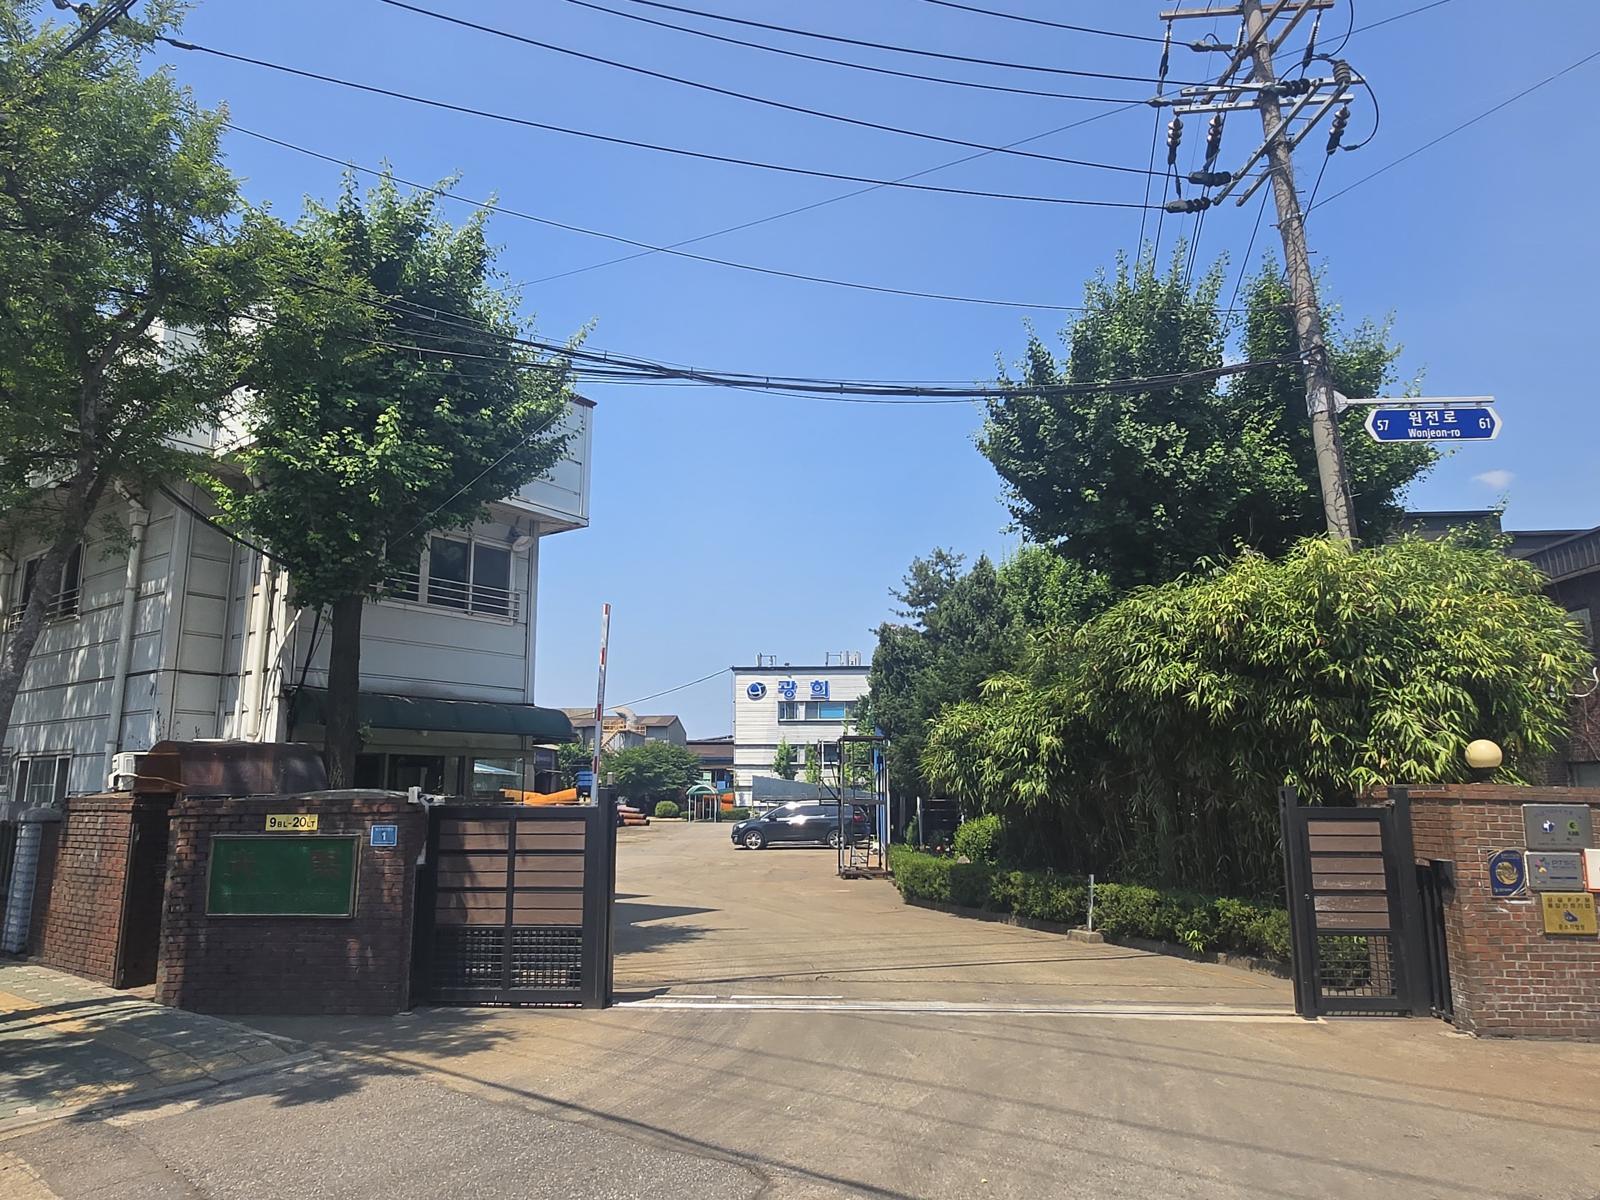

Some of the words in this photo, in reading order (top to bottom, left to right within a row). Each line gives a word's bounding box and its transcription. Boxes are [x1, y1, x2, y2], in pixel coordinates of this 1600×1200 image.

[1408, 410, 1458, 426] 원전로
[1478, 418, 1491, 429] 61
[1377, 419, 1389, 431] 57
[1408, 428, 1461, 439] Wonjeon-ro
[381, 831, 387, 841] 1
